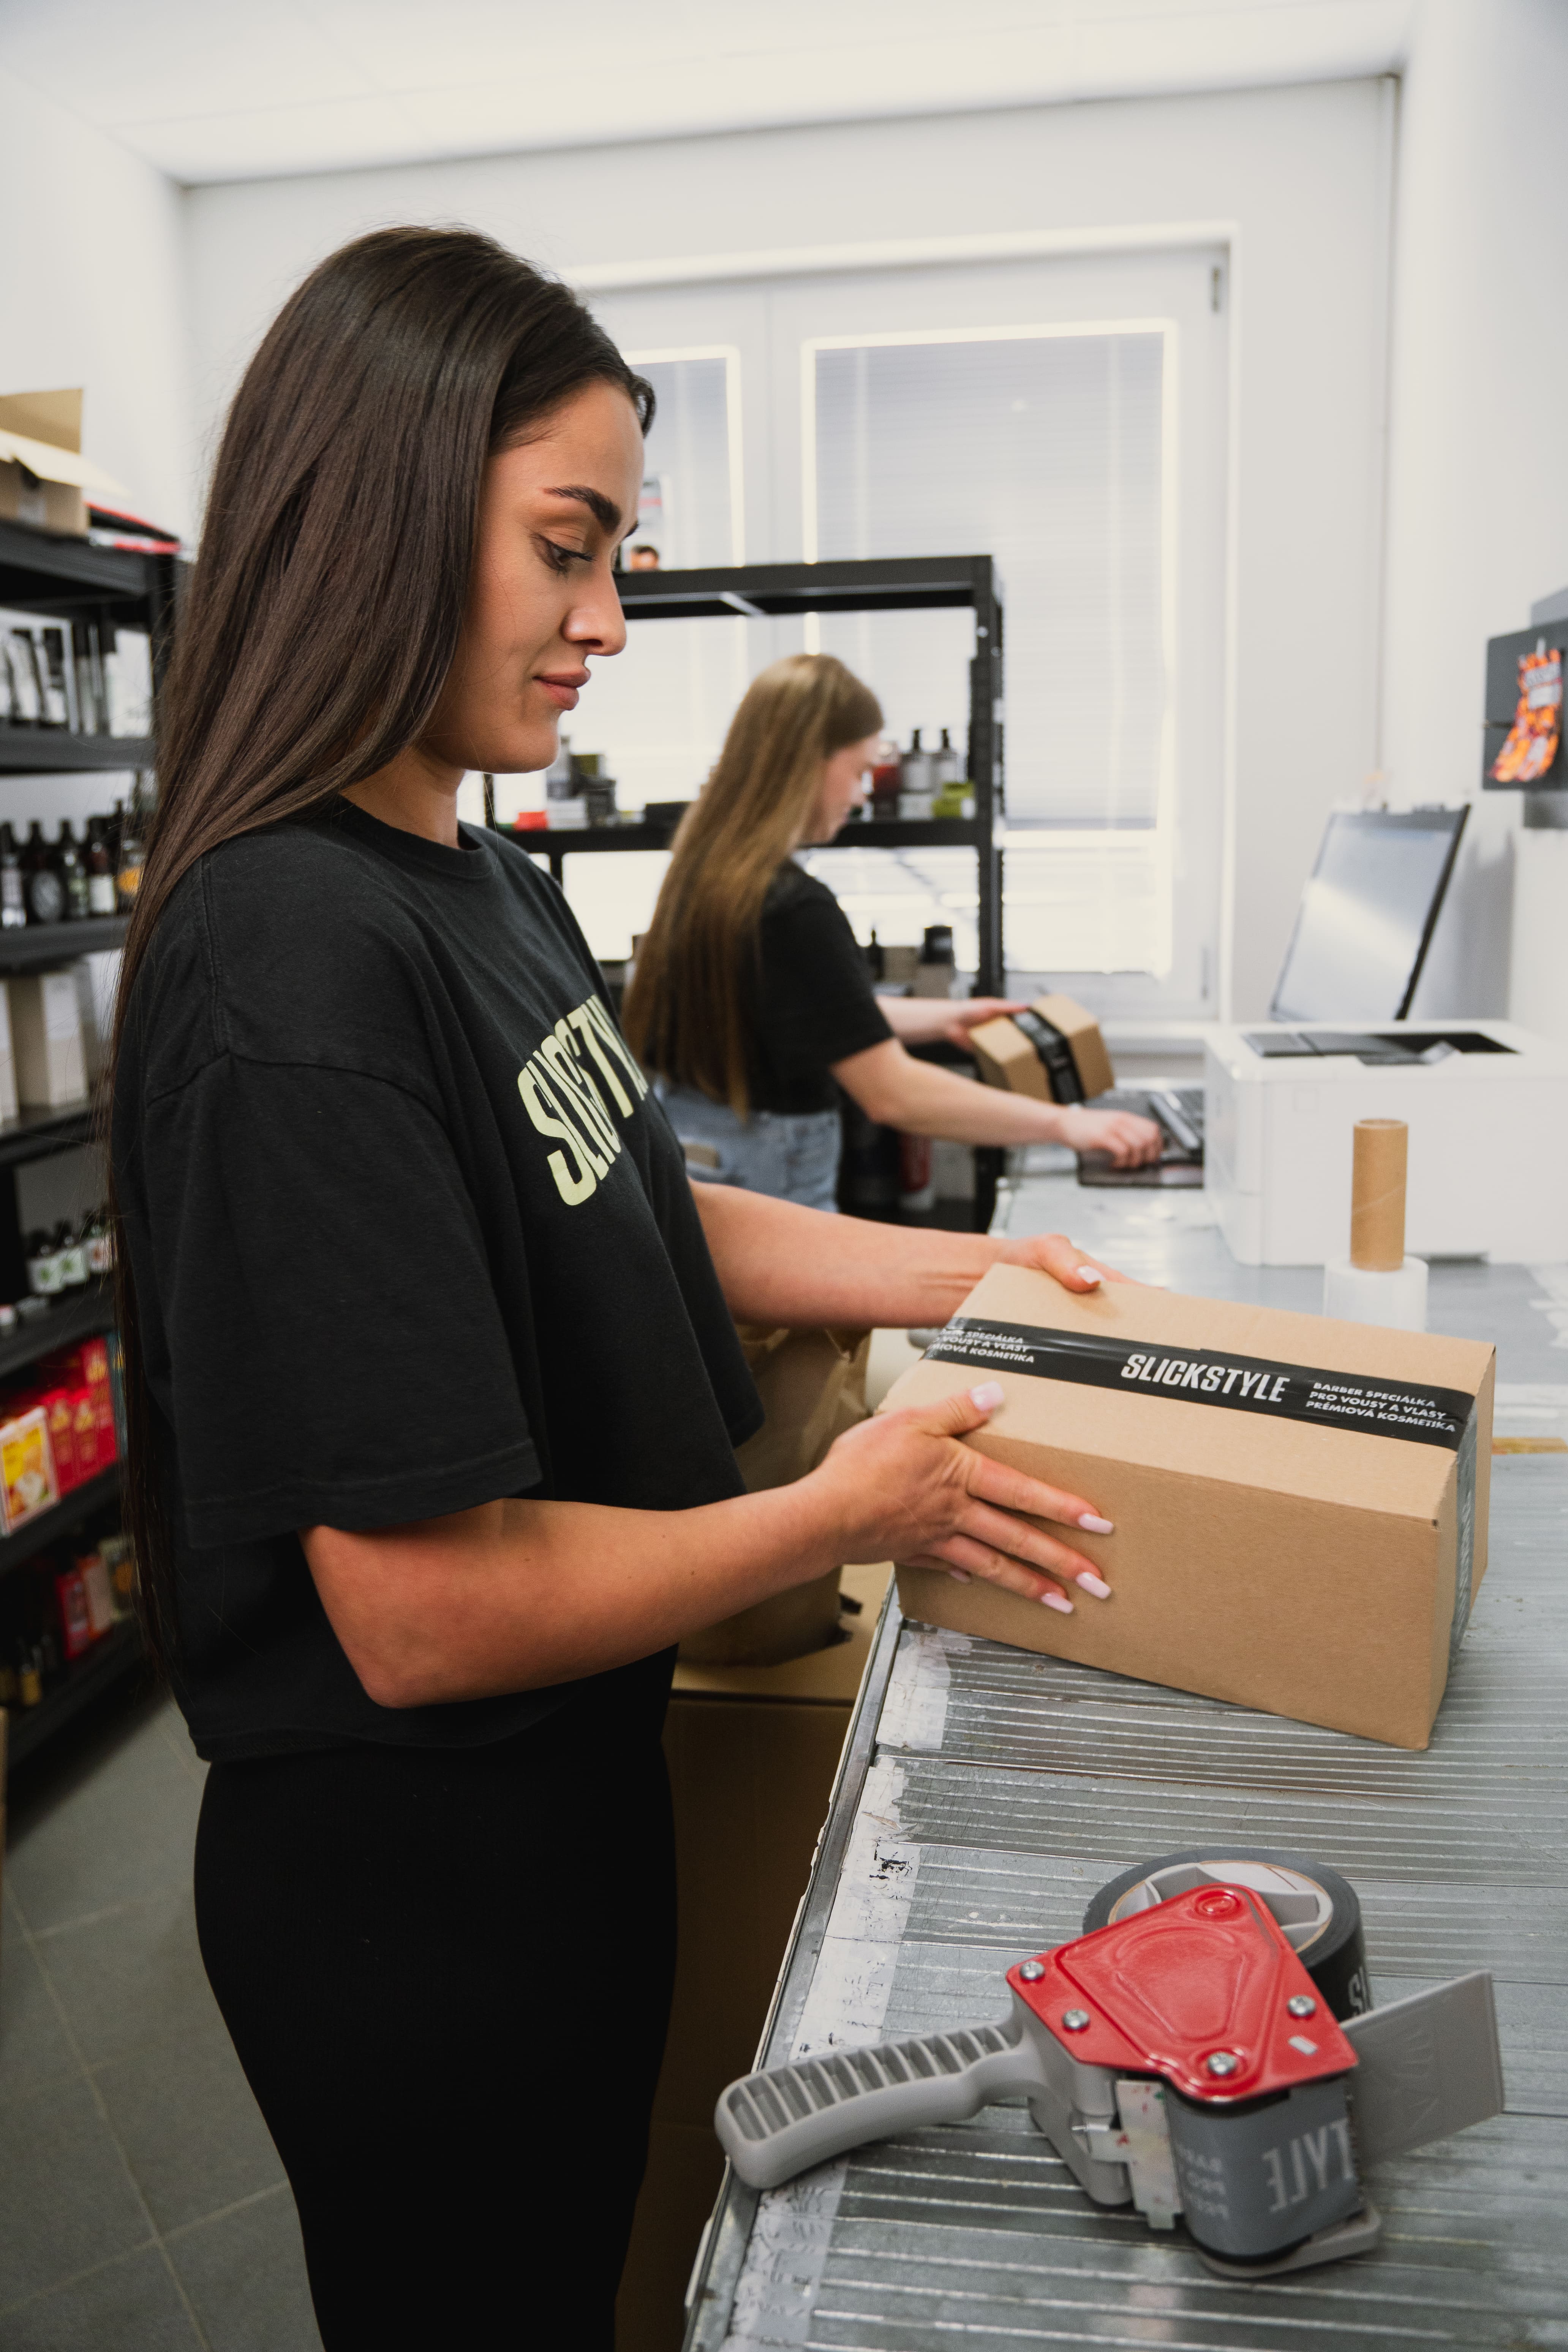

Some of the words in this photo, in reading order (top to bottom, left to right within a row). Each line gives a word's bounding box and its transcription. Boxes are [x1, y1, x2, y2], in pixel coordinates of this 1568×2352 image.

[943, 1336, 982, 1346] VOUSY
[994, 1342, 1029, 1353] VLASY
[965, 1331, 1023, 1344] SPECIÁLKA
[969, 1348, 1034, 1363] KOSMETIKA
[1121, 1354, 1290, 1402] SLICKSTYLE
[1309, 1392, 1337, 1401] PRO
[1341, 1396, 1387, 1409] VOUSY
[1403, 1406, 1446, 1420] VLASY
[1313, 1383, 1362, 1396] BARBER
[1365, 1390, 1436, 1408] SPECIÁLKA
[1306, 1401, 1374, 1418] PRÉMIOVÁ
[1377, 1412, 1456, 1432] KOSMETIKA
